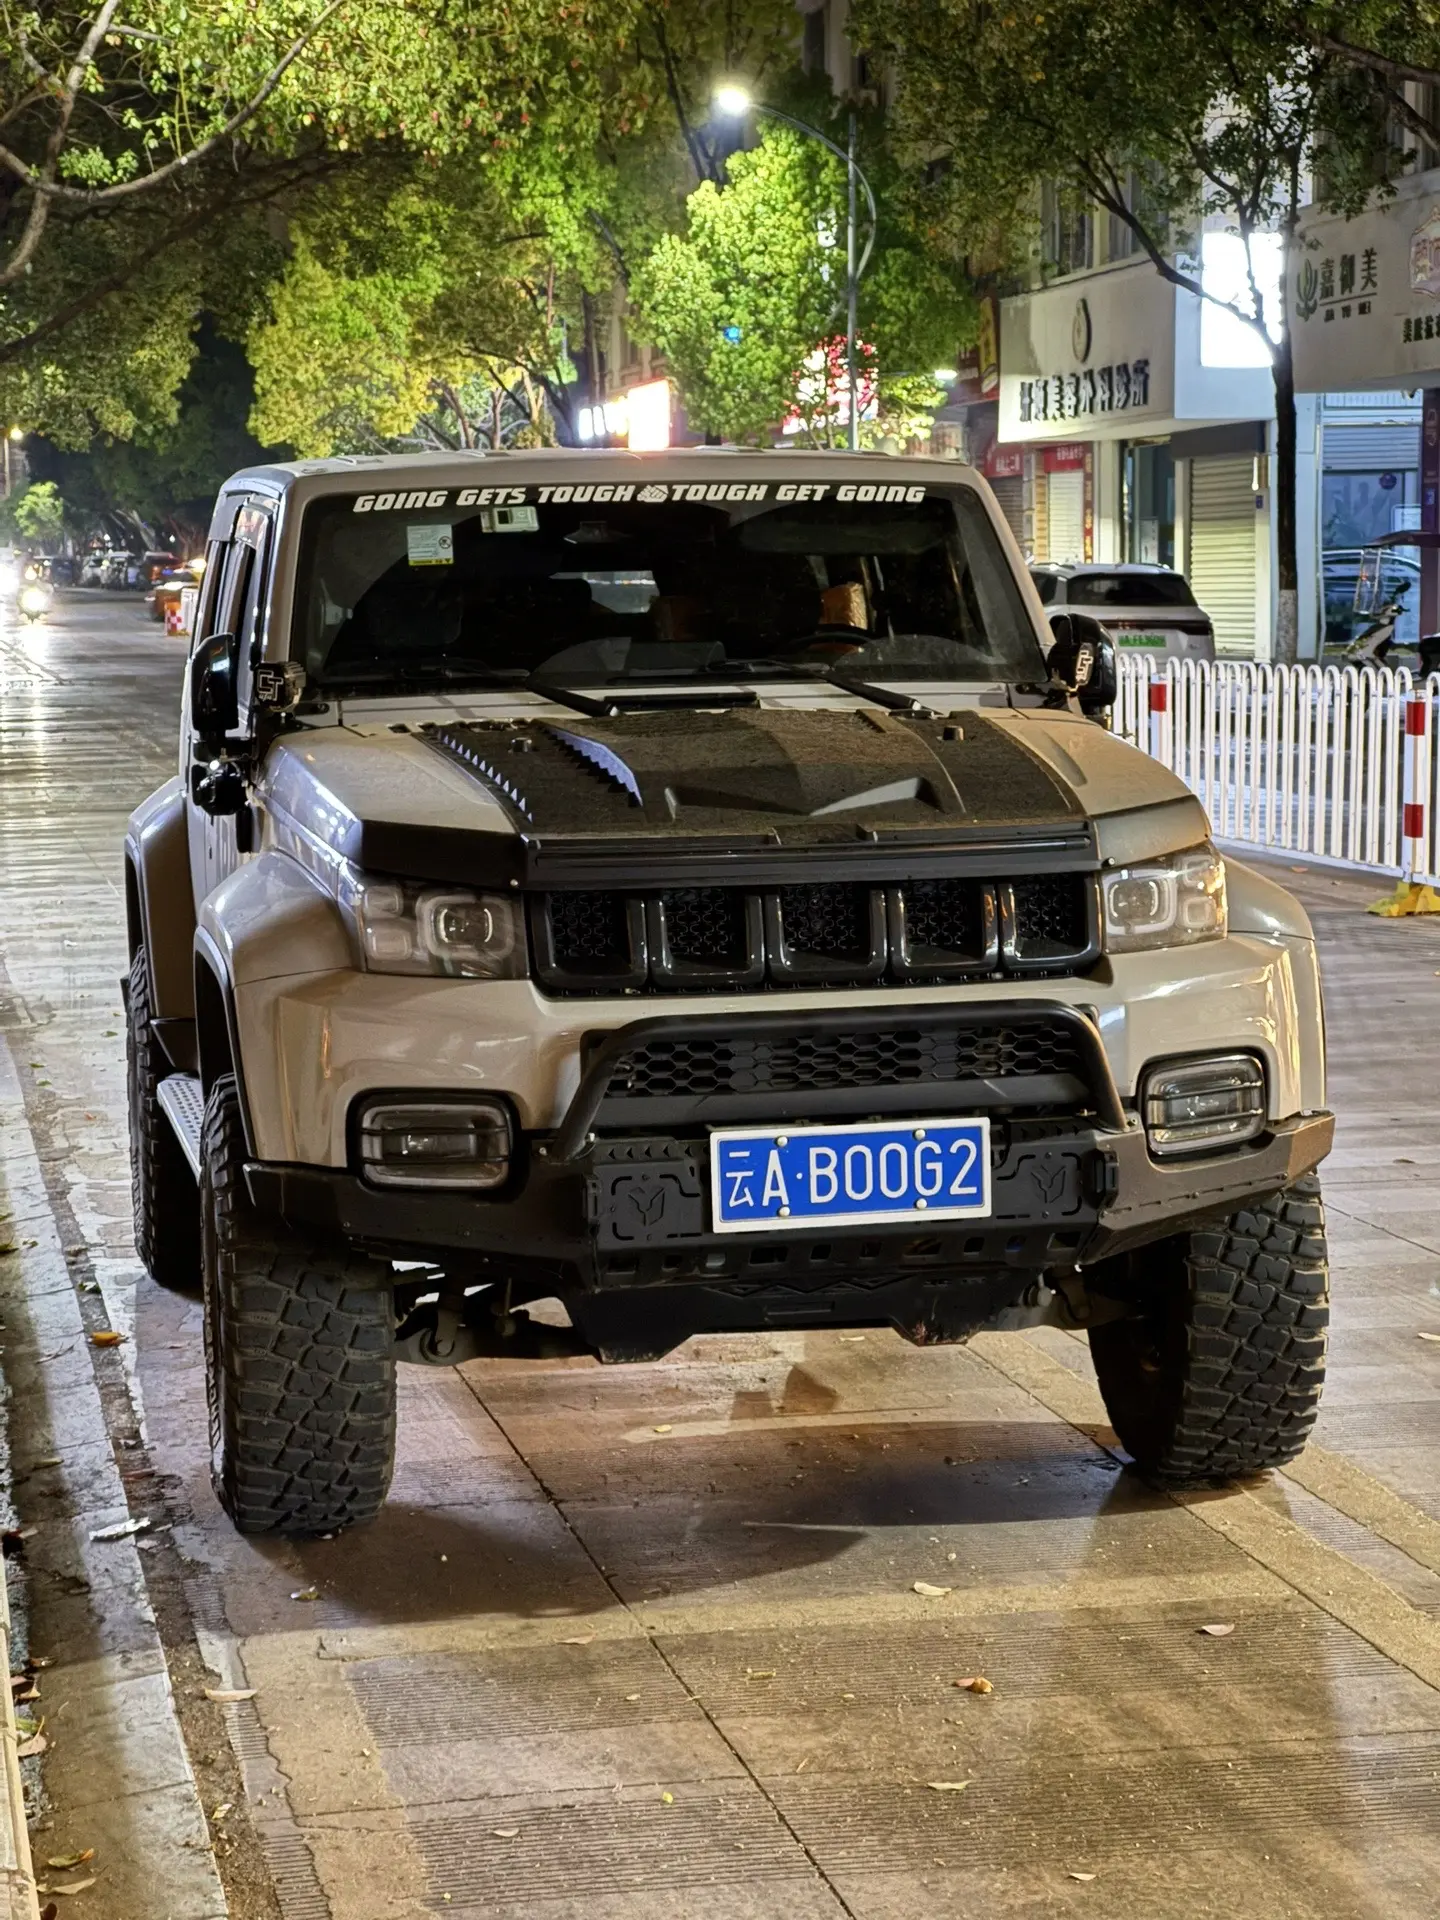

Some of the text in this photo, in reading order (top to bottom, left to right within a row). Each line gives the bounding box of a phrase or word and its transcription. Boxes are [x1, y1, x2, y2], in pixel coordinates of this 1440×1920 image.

[352, 484, 927, 513] GOING GETS TOUGH TOUGH GET GOING
